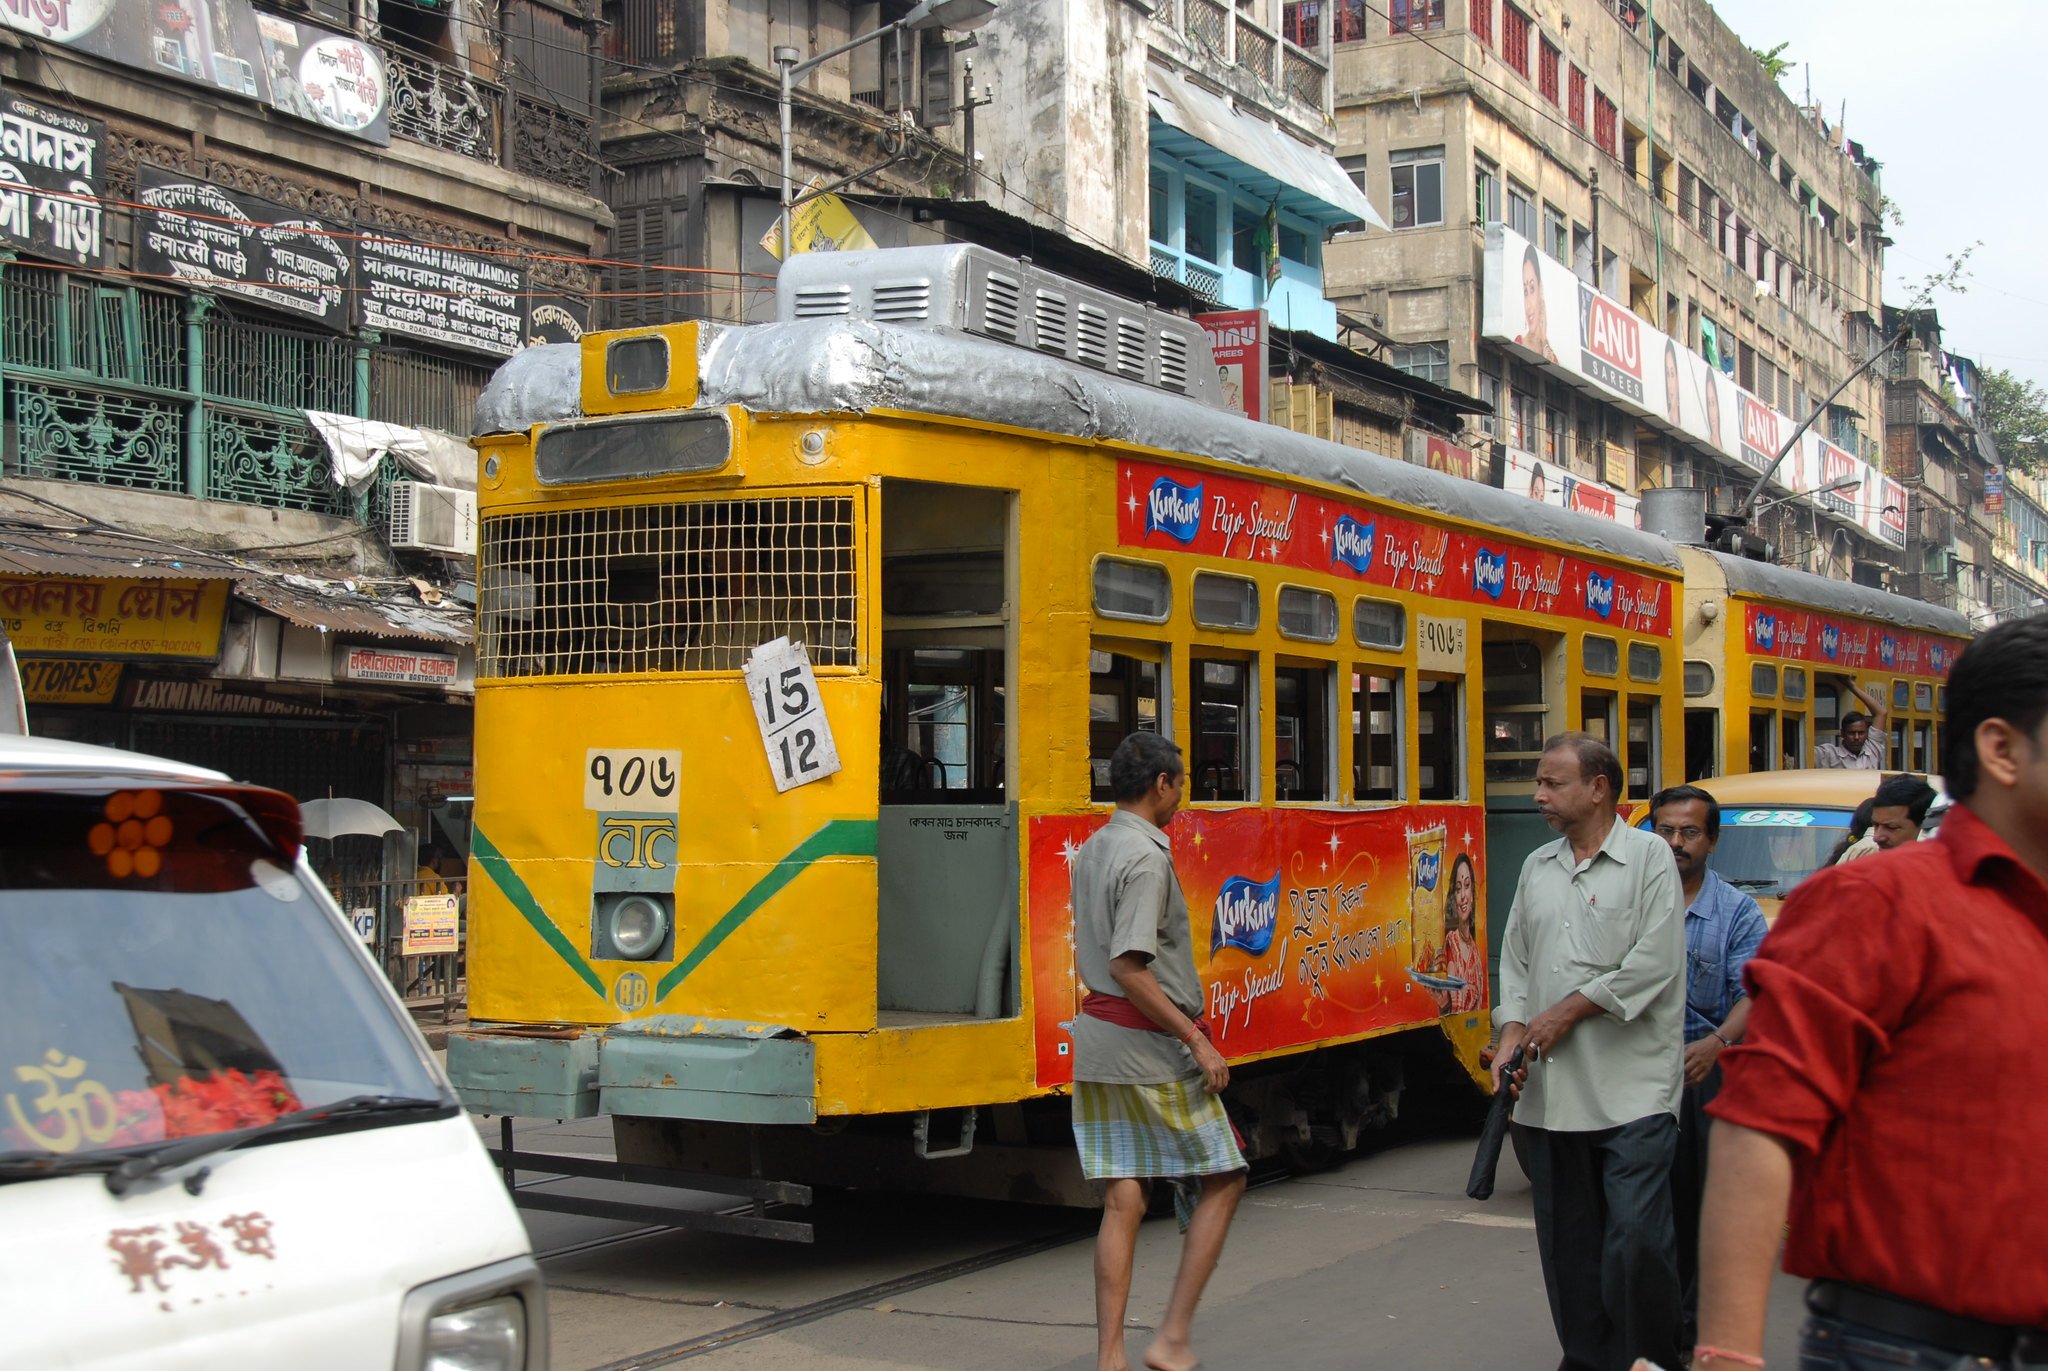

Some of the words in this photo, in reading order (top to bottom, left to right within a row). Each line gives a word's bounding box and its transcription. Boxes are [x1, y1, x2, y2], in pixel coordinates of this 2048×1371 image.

[166, 11, 185, 22] FREE
[36, 180, 102, 264] শাড়ী
[361, 232, 440, 268] SARDARAM
[442, 252, 519, 290] NARINJANDAS
[1213, 349, 1244, 359] AREES
[1594, 304, 1637, 369] ANU
[1592, 361, 1640, 398] SAREES
[1748, 405, 1777, 456] ANU
[1149, 487, 1200, 530] Kurkure
[1211, 495, 1244, 558] Pujo
[1247, 493, 1298, 560] Special
[1334, 524, 1373, 559] Kurkure
[1384, 533, 1409, 588] Pujo
[1409, 532, 1449, 592] Special
[1474, 555, 1504, 587] Kurkure
[1511, 561, 1533, 610] Pujo
[1532, 557, 1565, 612] Special
[1586, 576, 1614, 606] Kurkure
[1617, 585, 1635, 630] Pujo
[1634, 582, 1661, 631] Special
[22, 661, 100, 694] STORES
[131, 679, 188, 712] LAXMI
[764, 666, 810, 724] 15
[779, 728, 820, 779] 12
[600, 817, 676, 869] CTC
[909, 817, 935, 828] কেবল
[943, 830, 968, 840] জন্য
[1740, 809, 1805, 825] GR
[1215, 886, 1276, 948] Kurkure
[1210, 980, 1239, 1041] Pujo
[1241, 935, 1289, 1028] Special
